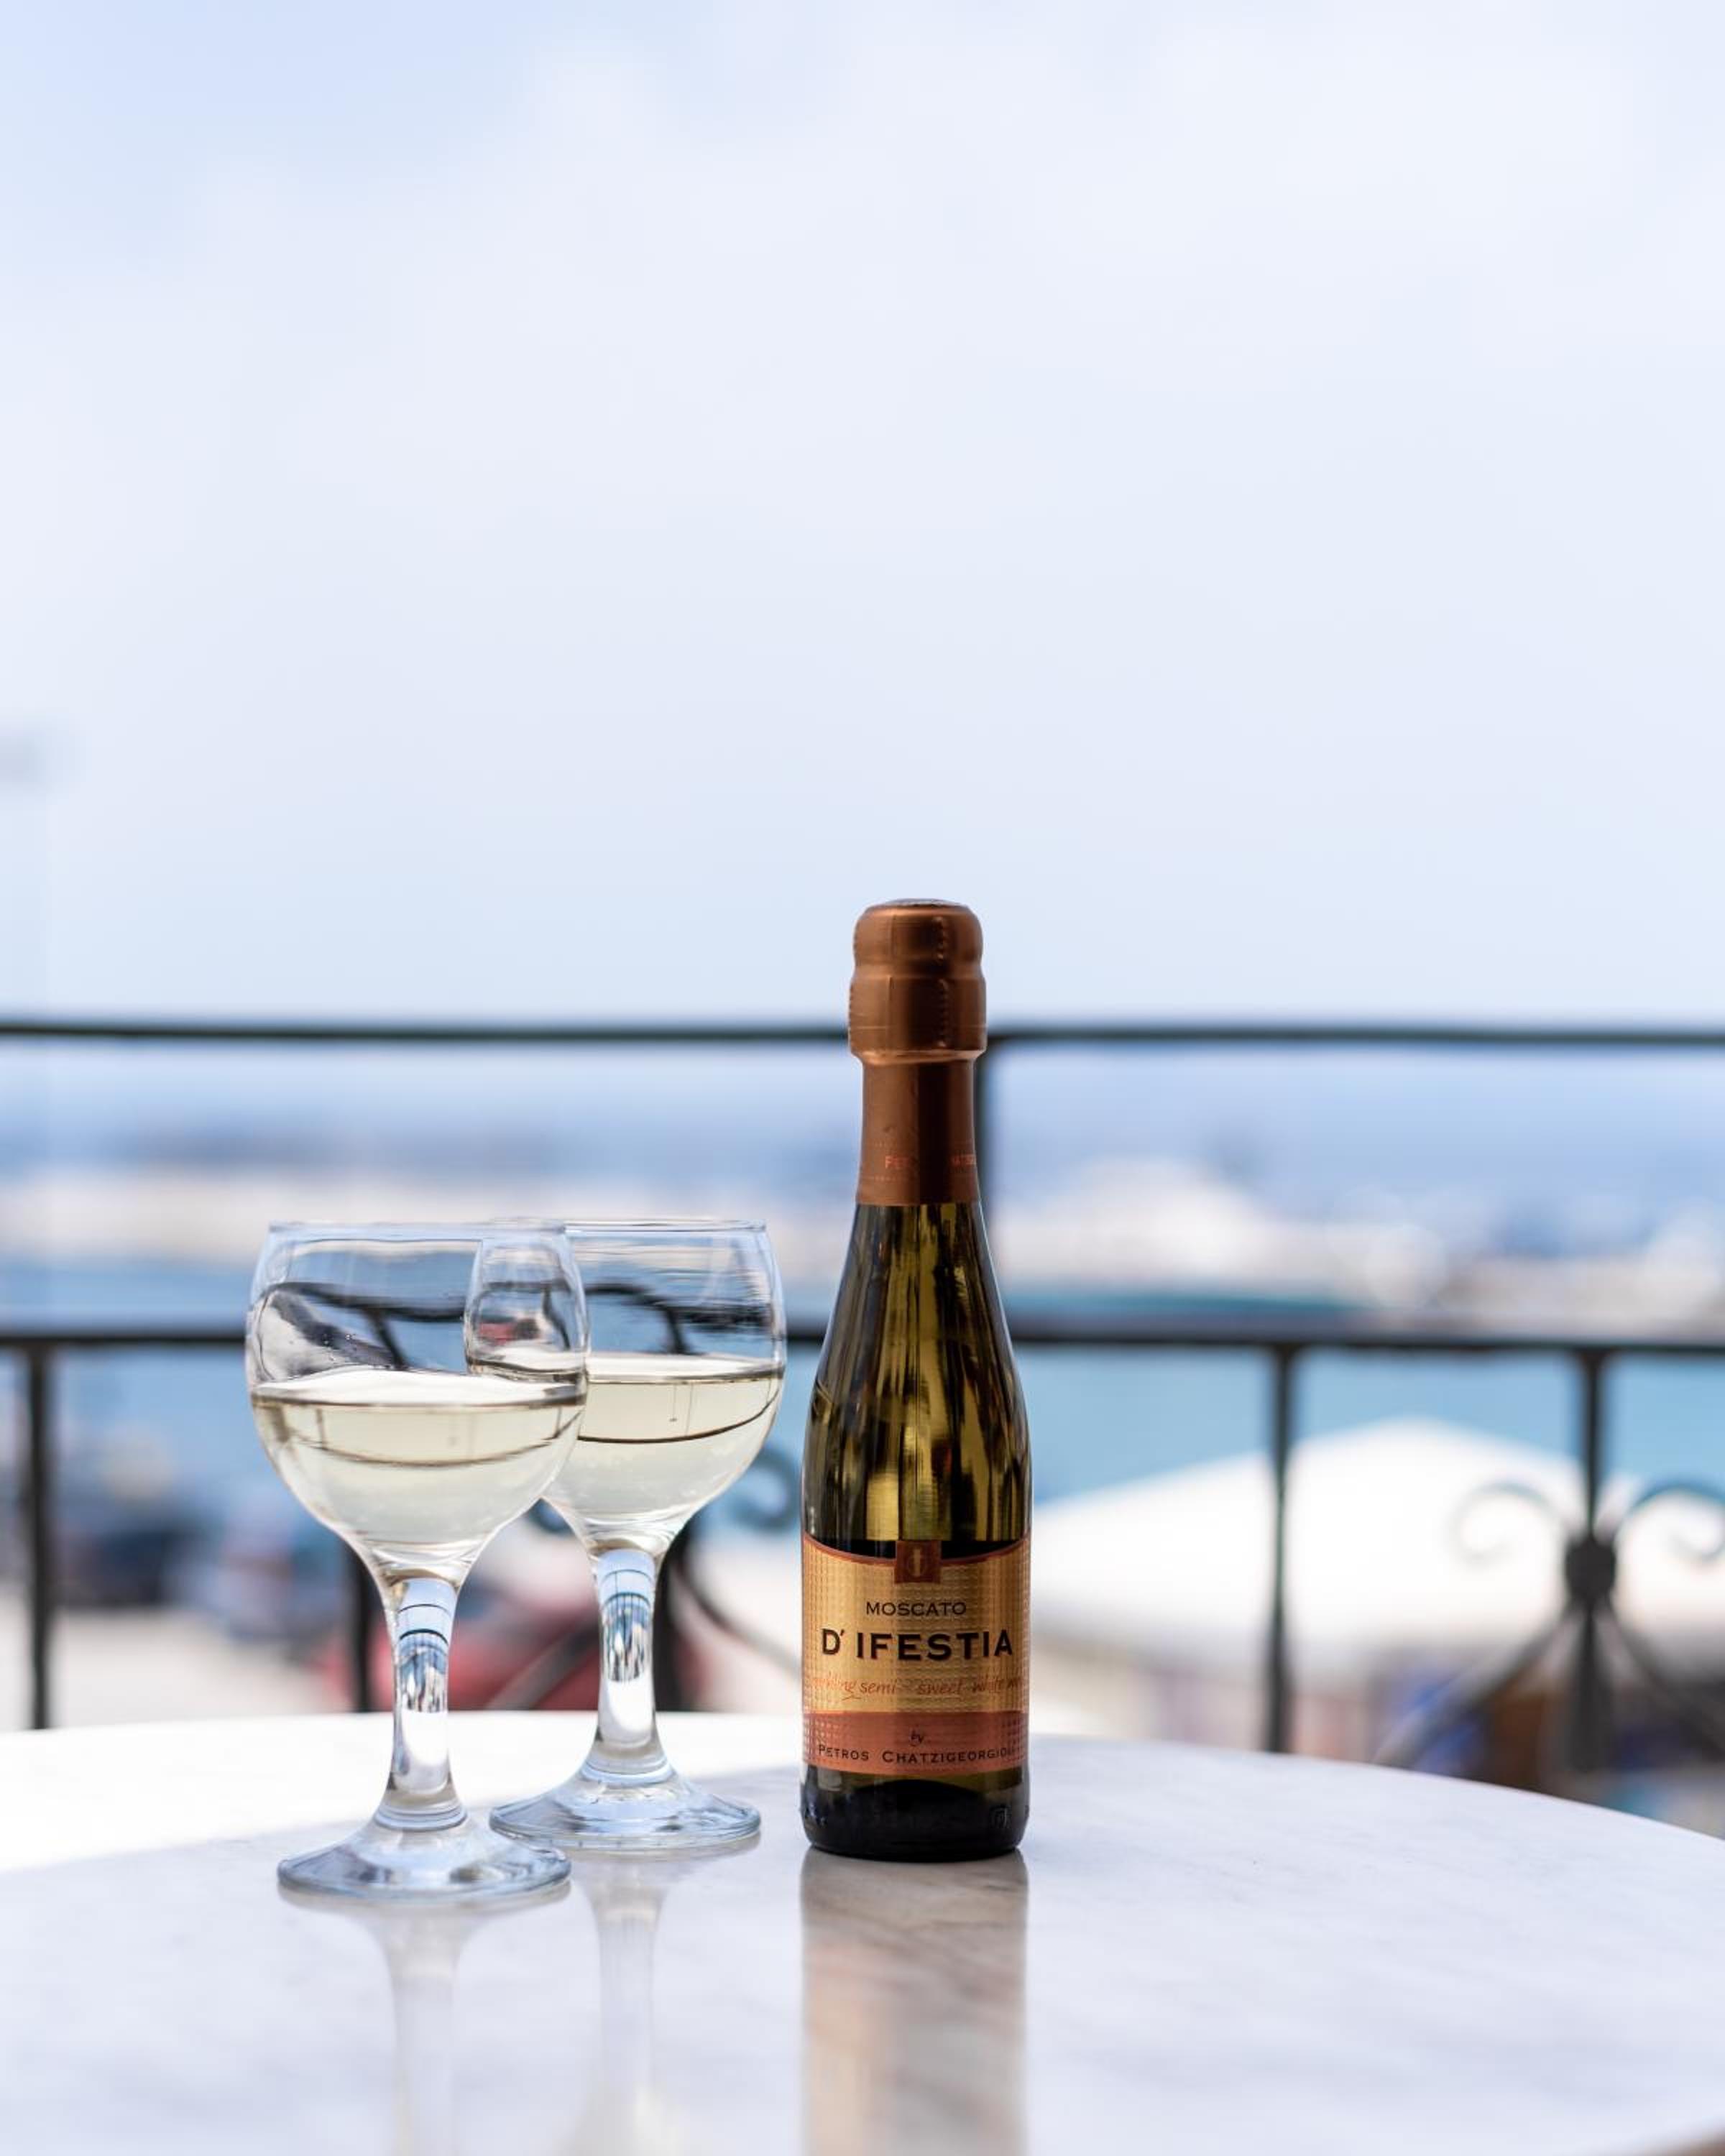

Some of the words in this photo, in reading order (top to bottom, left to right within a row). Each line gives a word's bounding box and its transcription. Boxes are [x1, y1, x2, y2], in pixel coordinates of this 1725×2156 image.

[866, 1602, 966, 1616] MOSCATO
[856, 1629, 1013, 1661] IFESTIA
[860, 1680, 897, 1695] semi
[819, 1744, 869, 1761] PETROS
